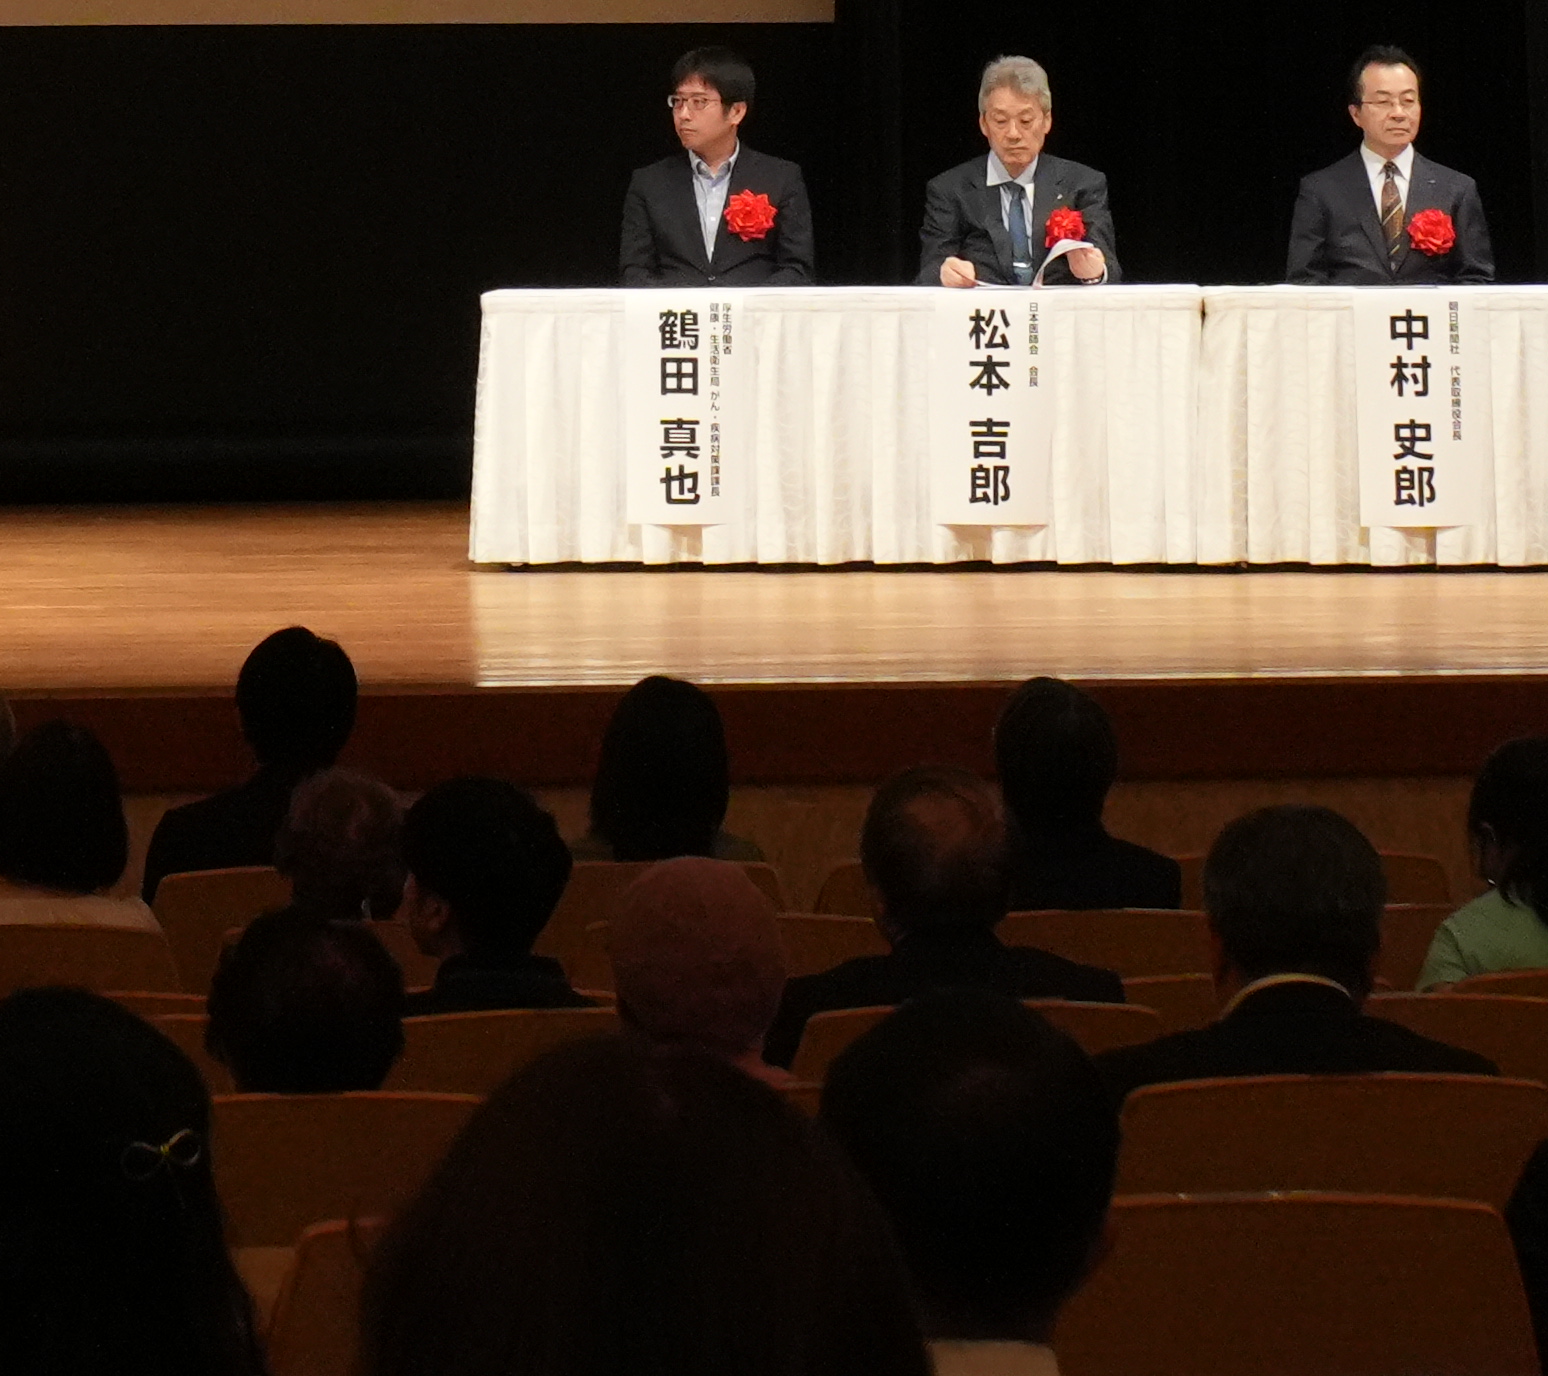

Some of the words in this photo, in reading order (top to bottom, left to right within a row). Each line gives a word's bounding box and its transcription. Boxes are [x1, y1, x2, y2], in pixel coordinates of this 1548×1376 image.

[658, 309, 700, 396] 鶴田
[968, 308, 1011, 397] 松本
[1389, 308, 1432, 398] 中村
[659, 417, 701, 505] 真也
[968, 417, 1011, 506] 吉郎
[1393, 418, 1436, 508] 史郎
